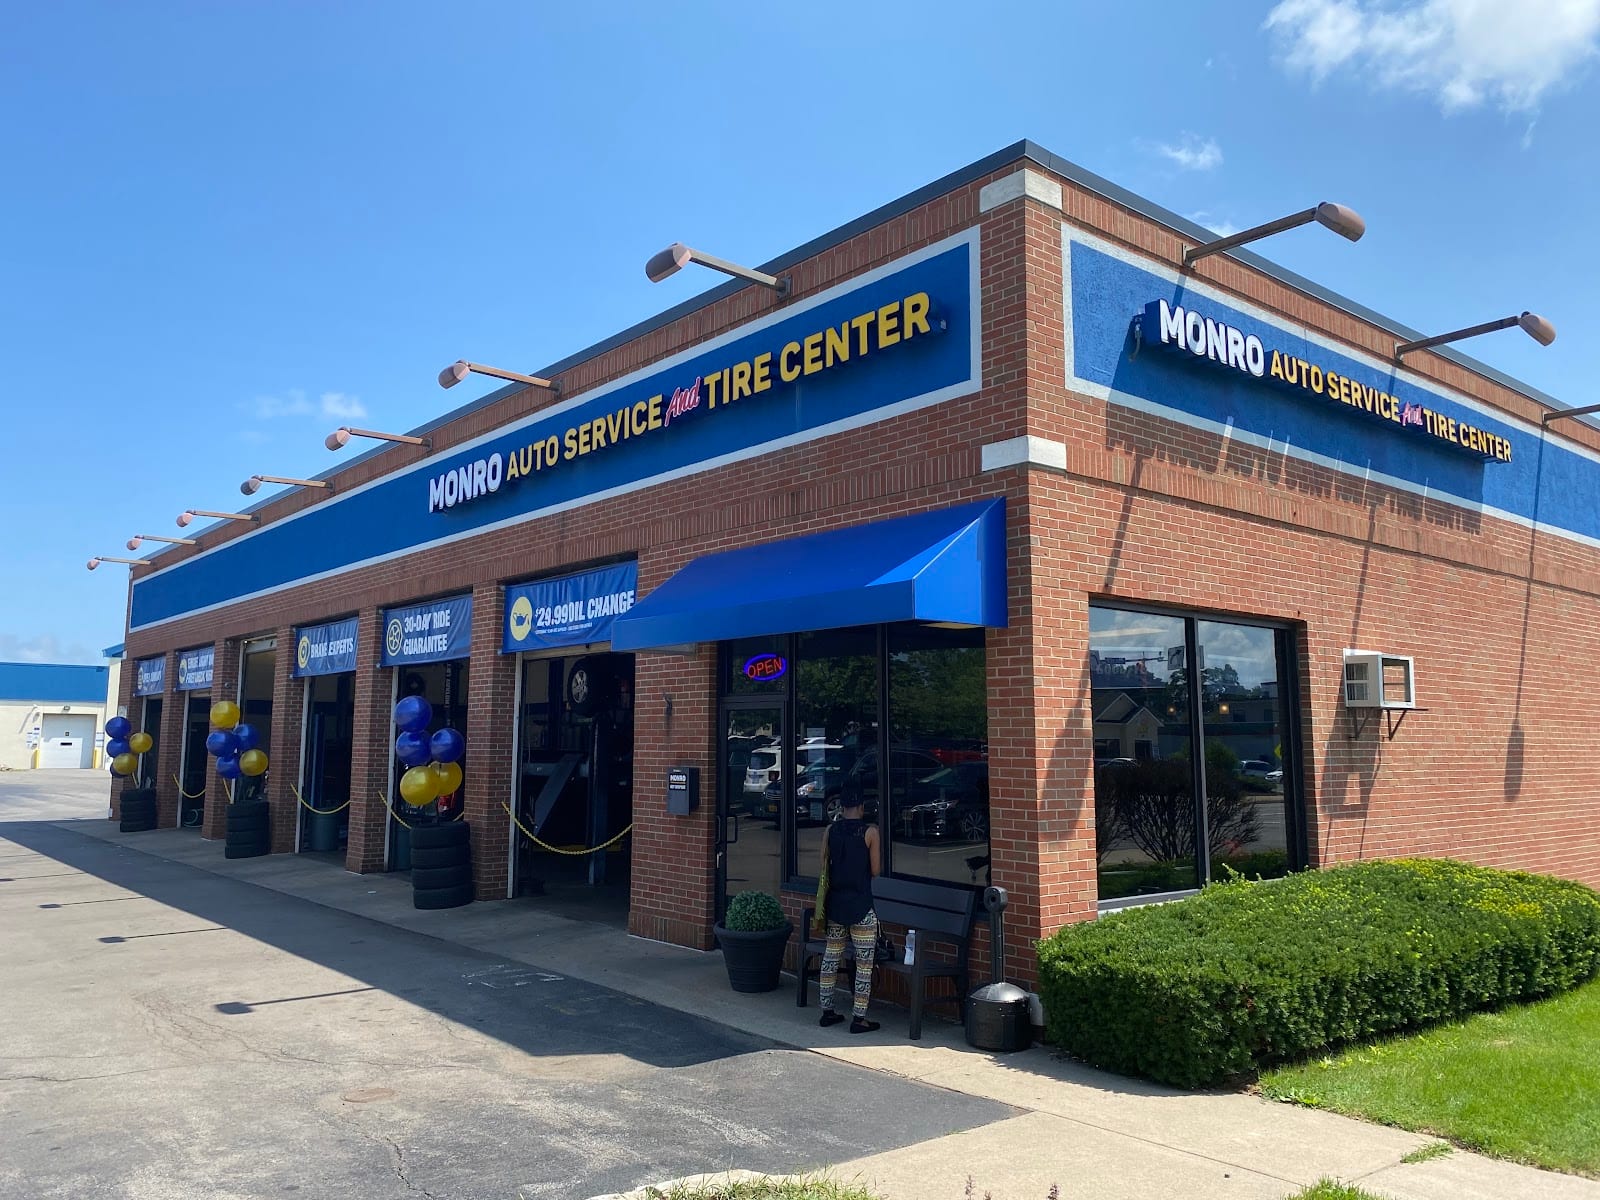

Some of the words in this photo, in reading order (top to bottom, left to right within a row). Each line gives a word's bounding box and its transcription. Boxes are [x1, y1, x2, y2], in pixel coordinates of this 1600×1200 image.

[1159, 299, 1265, 378] MONRO
[1270, 349, 1324, 394] AUTO
[1327, 372, 1401, 424] SERVICE
[1423, 408, 1458, 443] TIRE
[1460, 422, 1512, 462] CENTER
[428, 453, 502, 513] MONRO
[506, 435, 559, 481] AUTO
[564, 395, 662, 460] SERVICE
[665, 376, 702, 427] And
[703, 352, 772, 410] TIRE
[779, 292, 932, 382] CENTER
[569, 601, 586, 622] OIL
[587, 591, 635, 619] CHANGE
[404, 612, 432, 633] 30-DAY
[433, 609, 451, 629] RIDE
[328, 637, 354, 656] EXPERTS
[403, 633, 448, 655] GUARANTEE
[746, 657, 782, 679] OPEN
